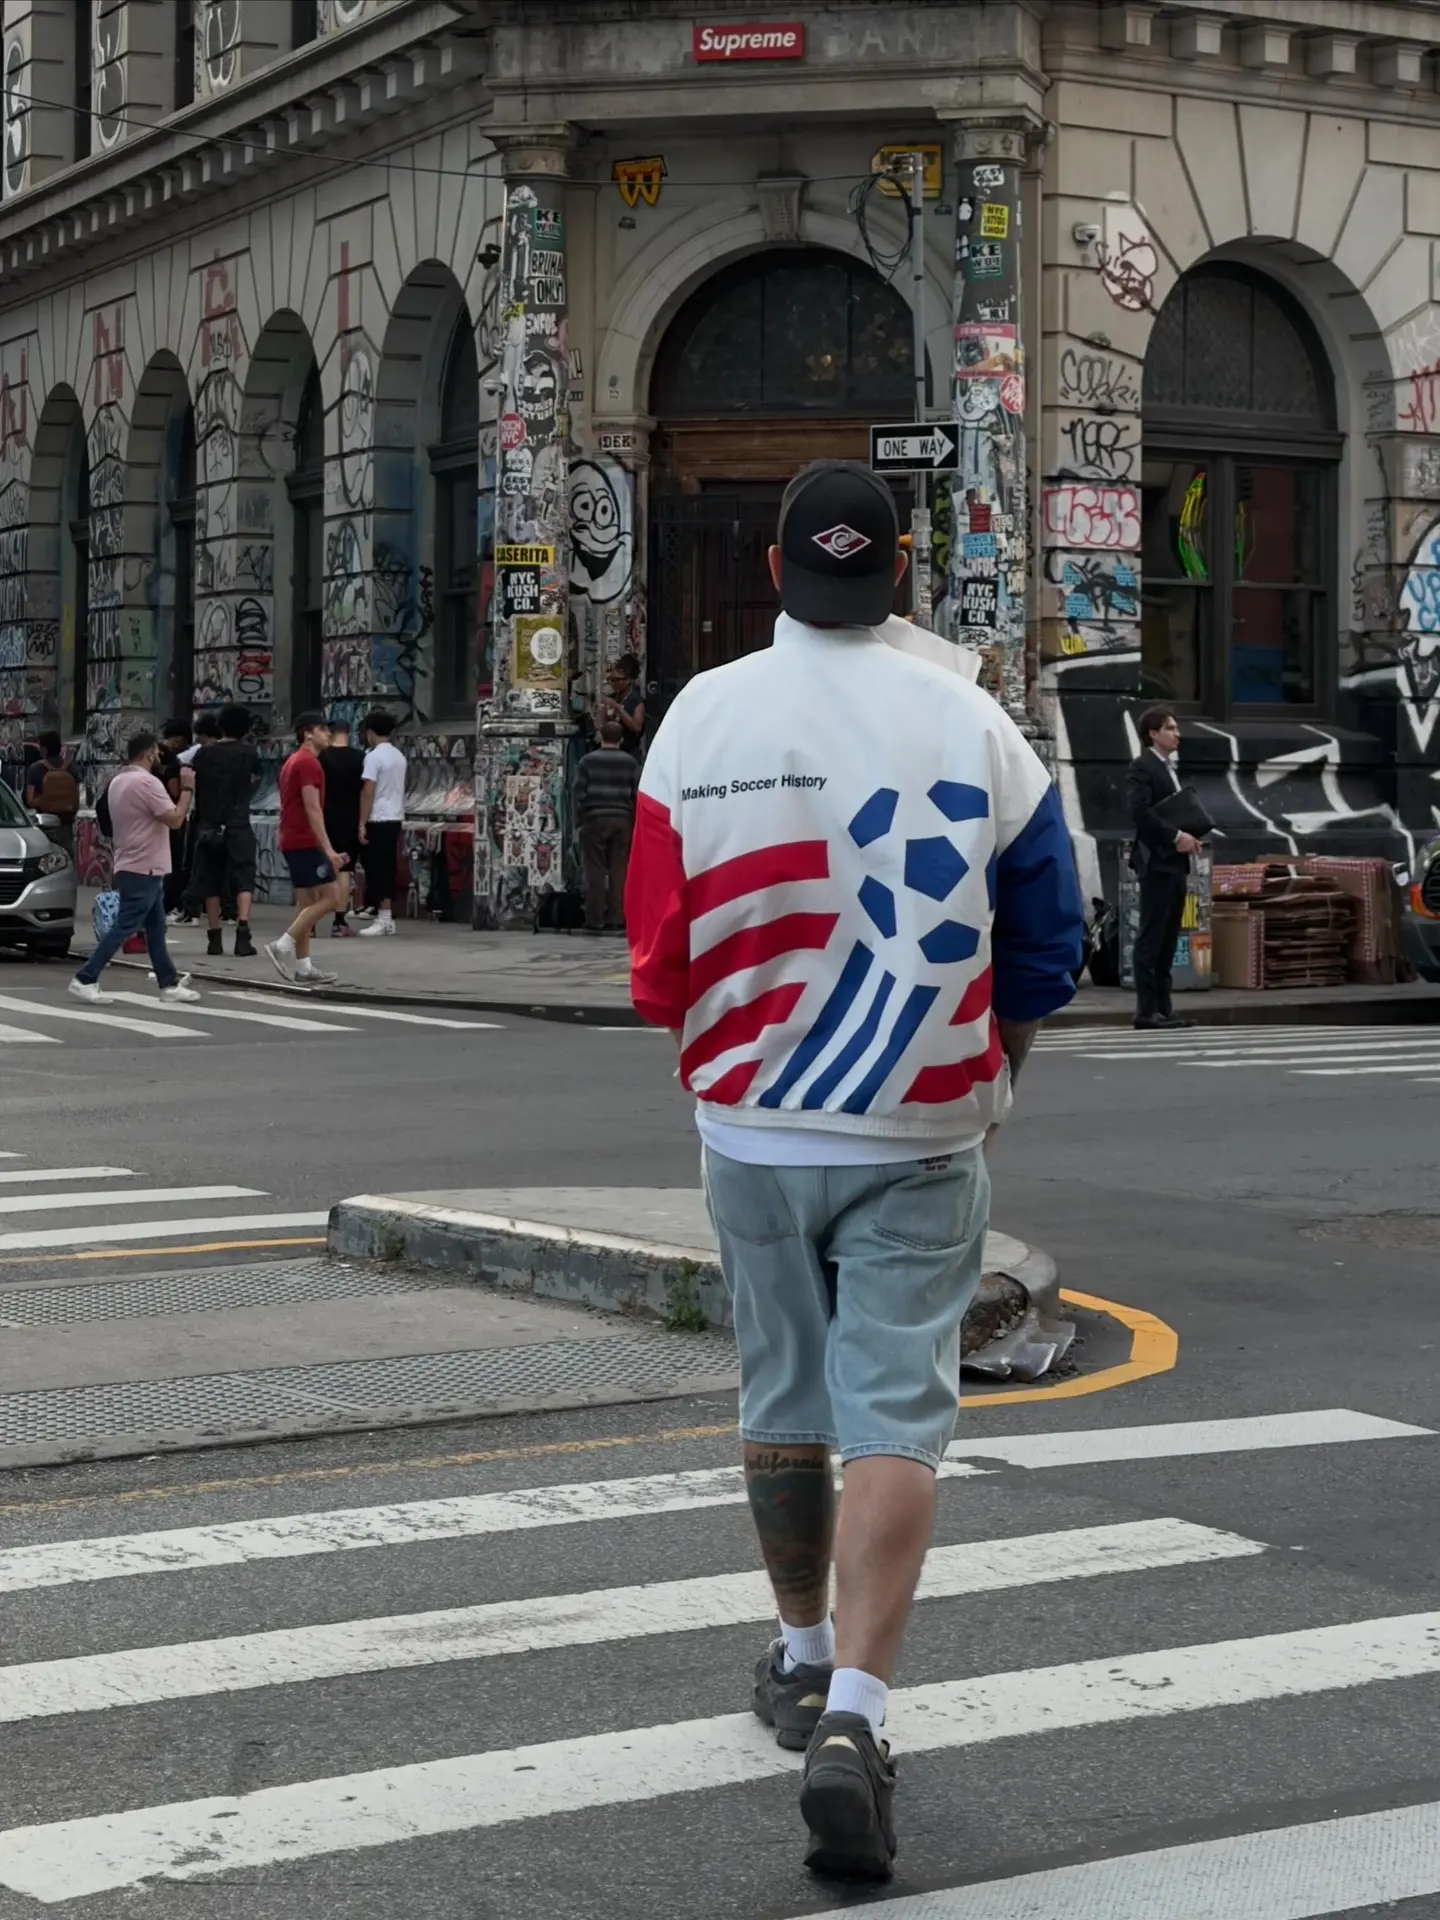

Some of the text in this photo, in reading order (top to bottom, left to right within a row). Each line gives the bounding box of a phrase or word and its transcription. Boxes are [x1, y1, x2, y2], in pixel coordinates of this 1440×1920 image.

[699, 28, 796, 56] Supreme
[884, 439, 945, 456] ONE WAY
[509, 571, 535, 584] NYC
[507, 585, 538, 598] KUSH
[967, 583, 993, 597] NYC
[513, 598, 534, 610] CO.
[963, 597, 995, 611] KUSH
[968, 611, 989, 624] CO.
[681, 774, 827, 801] Making Soccer History
